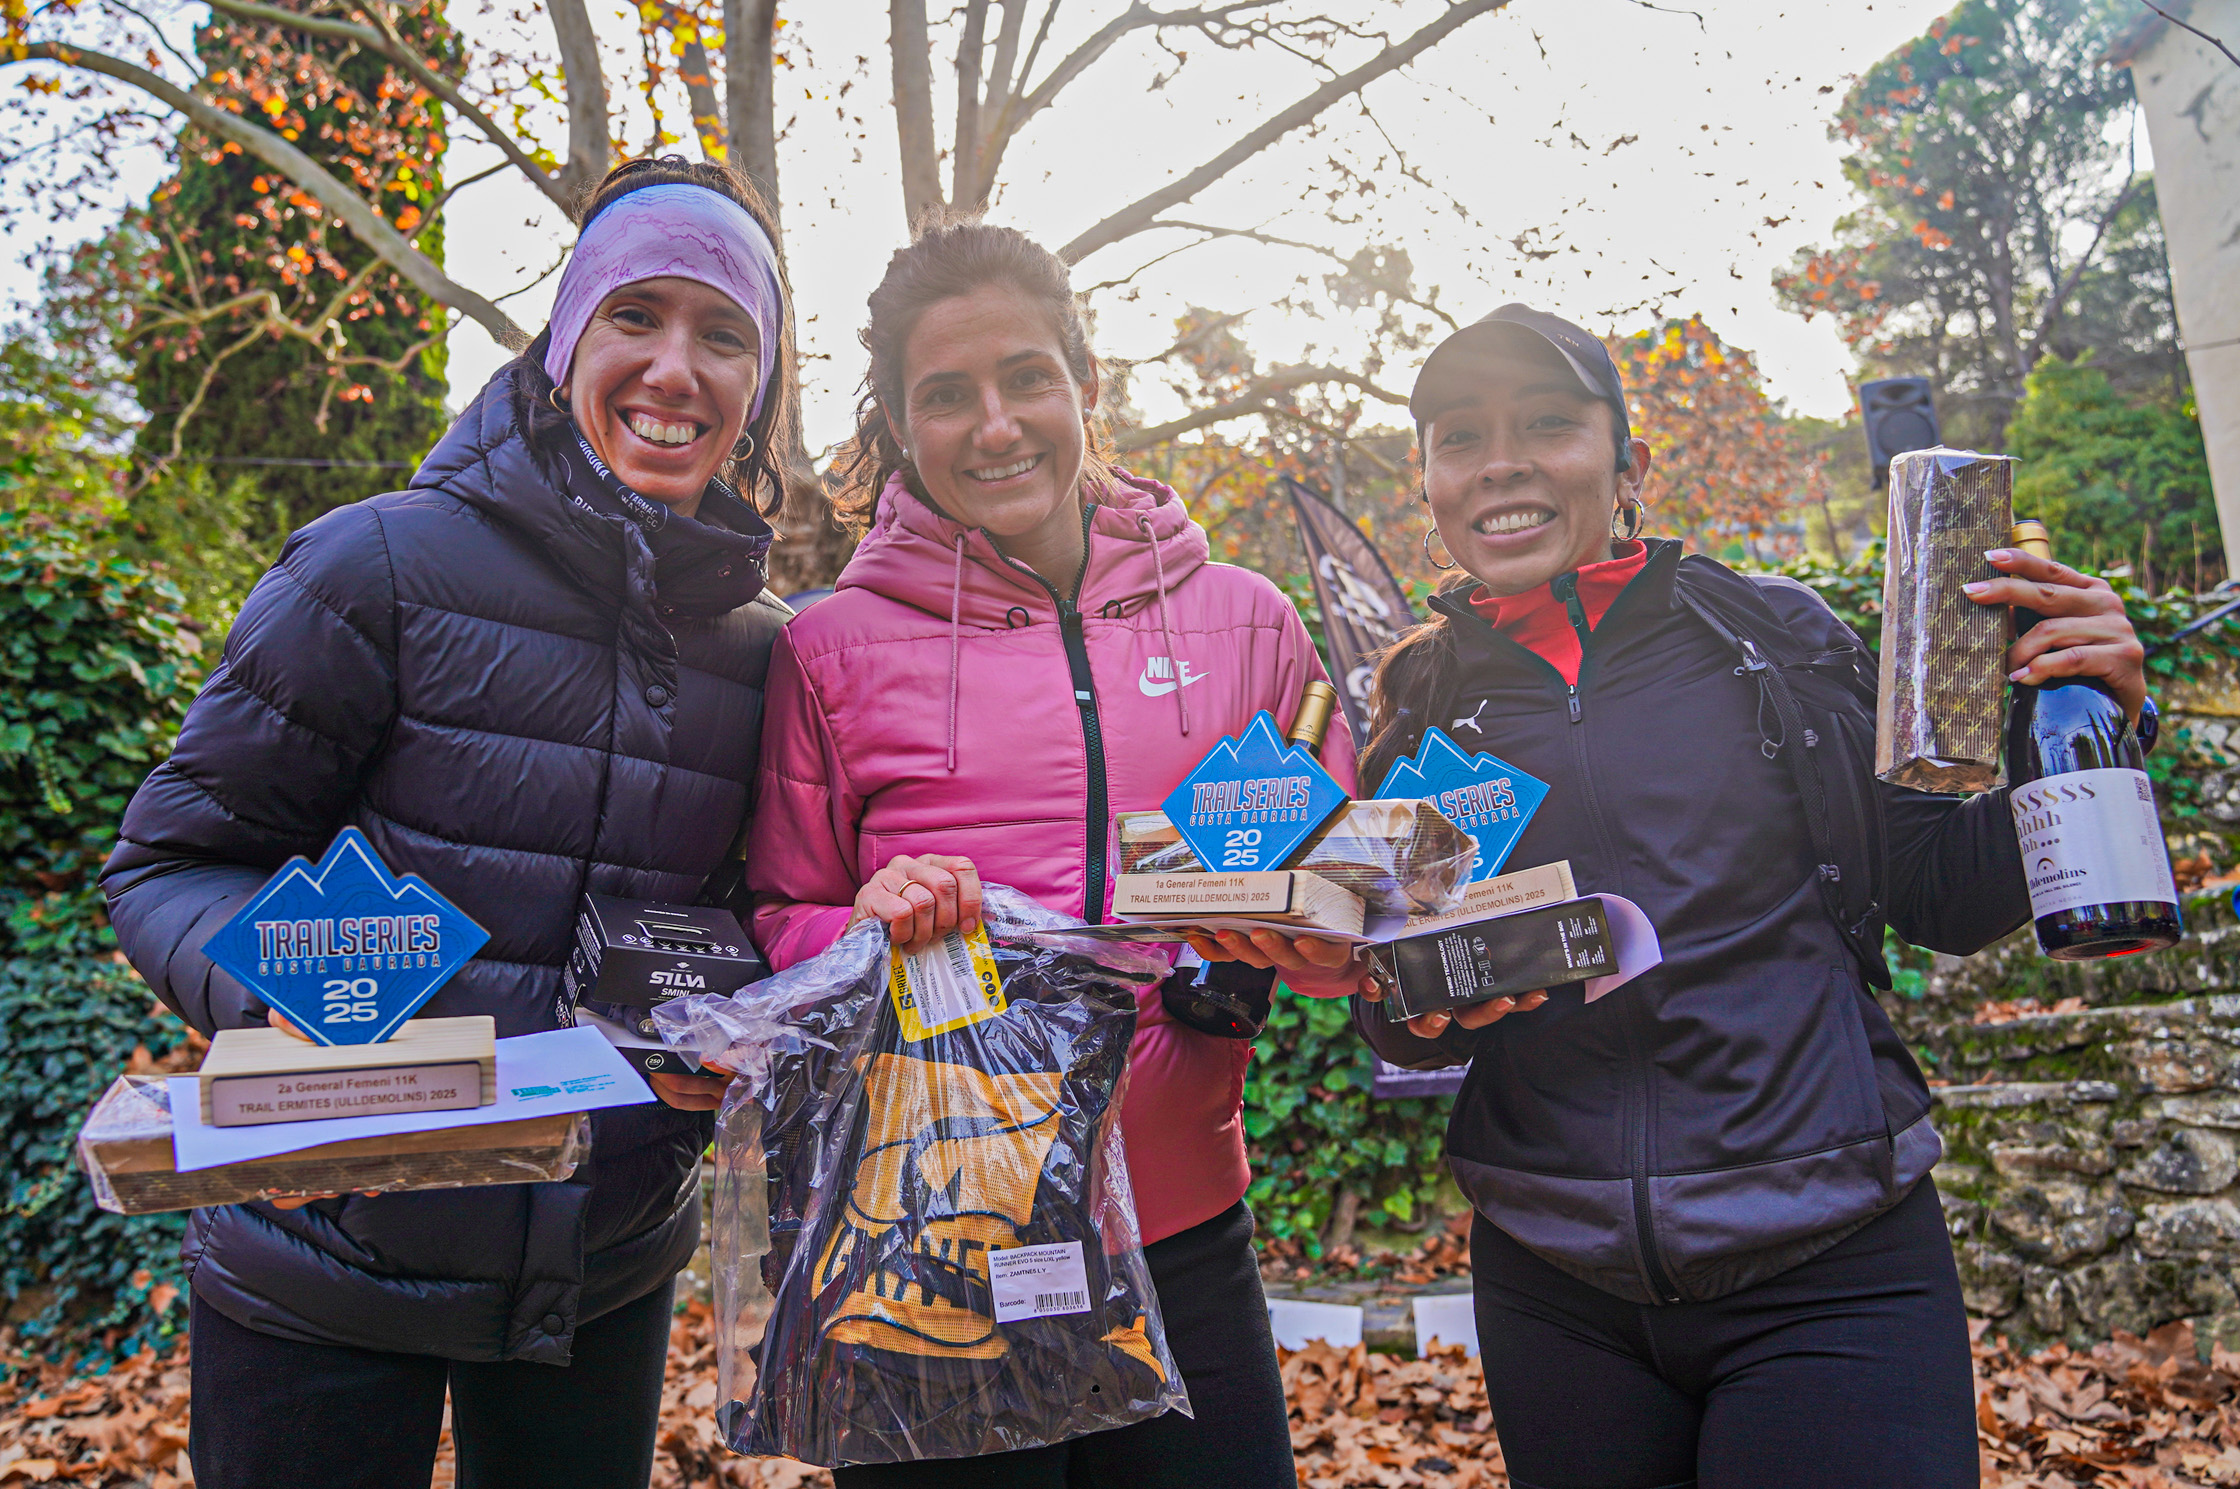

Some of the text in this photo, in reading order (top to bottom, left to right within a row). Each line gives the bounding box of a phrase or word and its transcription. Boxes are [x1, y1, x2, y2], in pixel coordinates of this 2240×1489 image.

[628, 491, 658, 518] TARMAC
[1192, 775, 1311, 814] TRAILSERIES
[1190, 809, 1307, 826] COSTA DAURADA
[1459, 807, 1520, 831] AURADA
[1225, 829, 1262, 847] 20
[1222, 849, 1259, 867] 25
[1155, 877, 1245, 889] 1a General Femeni 11K
[1497, 882, 1514, 894] 11K
[1130, 892, 1270, 904] TRAIL ERMITES (ULLDEMOLINS) 2025
[1404, 918, 1418, 928] AIL
[1457, 893, 1524, 918] (ULLDEMOLINS)
[1525, 889, 1545, 901] 2025
[255, 914, 440, 961] TRAILSERIES
[259, 953, 441, 975] COSTA DAURADA
[1437, 940, 1455, 997] HYBRID TECHNOLOGY
[322, 978, 378, 1001] 20
[649, 971, 706, 989] SILVA
[893, 963, 910, 995] GRIVEL
[323, 1001, 379, 1024] 25
[278, 1074, 418, 1095] 2a General Femeni 11K
[238, 1089, 457, 1114] TRAIL ERMITES (ULLDEMOLINS) 2025
[1010, 1251, 1038, 1260] BACKPACK
[1038, 1248, 1066, 1256] MOUNTAIN
[999, 1299, 1026, 1308] Barcode:
